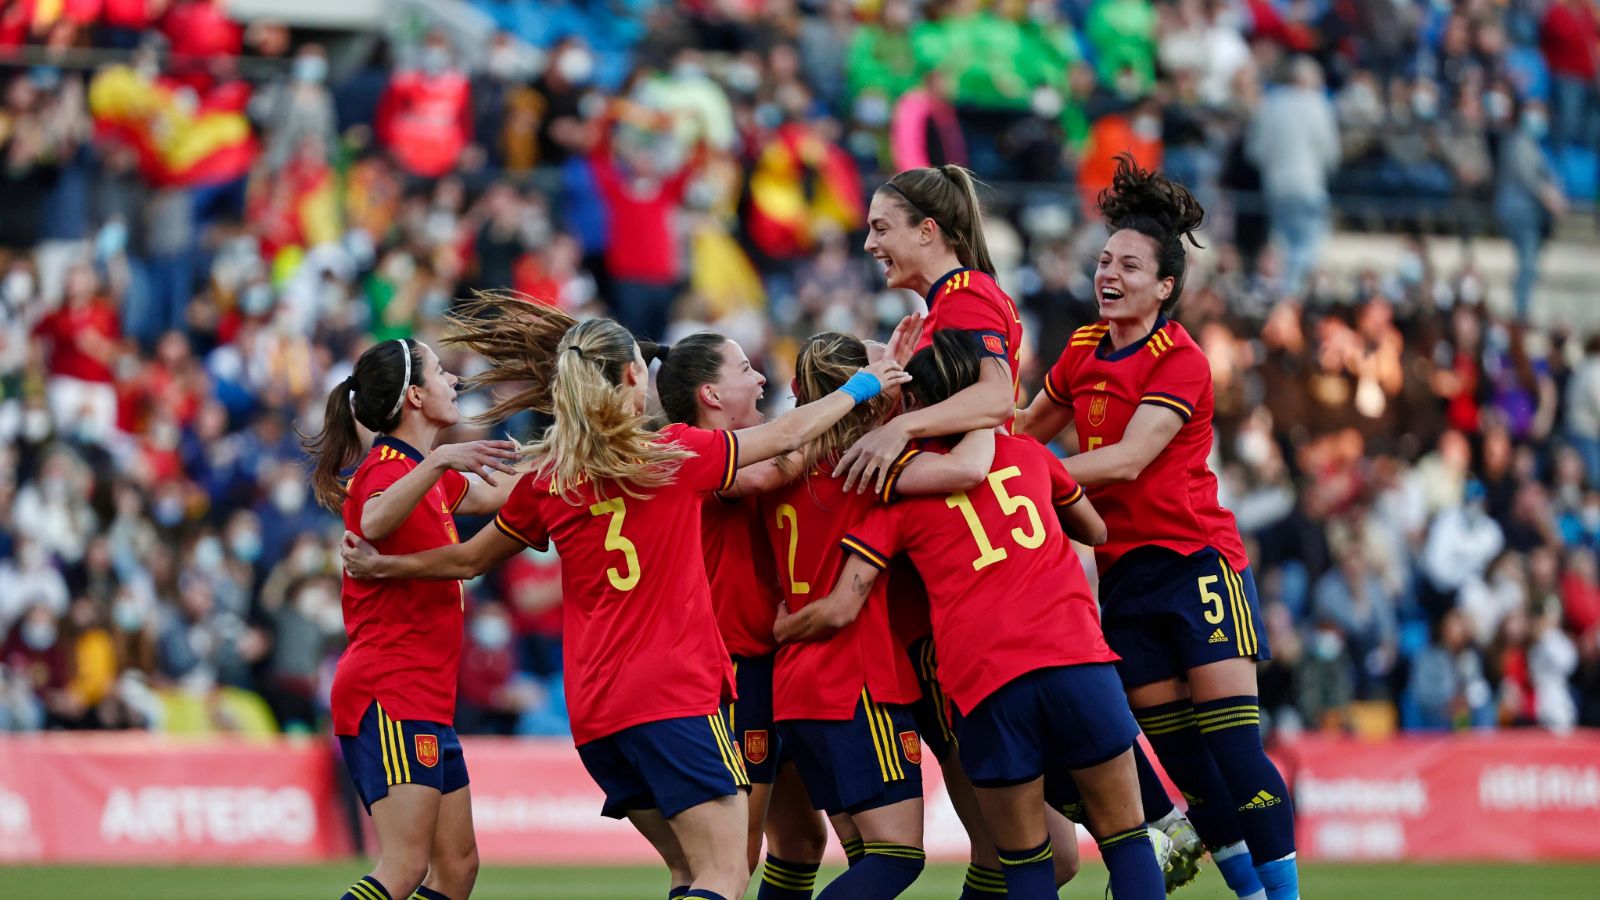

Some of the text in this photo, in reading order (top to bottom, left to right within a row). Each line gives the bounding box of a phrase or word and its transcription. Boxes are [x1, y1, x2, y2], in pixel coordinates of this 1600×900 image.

[589, 496, 641, 592] 3
[776, 503, 810, 594] 2
[945, 465, 1047, 572] 15
[1198, 575, 1225, 625] 5
